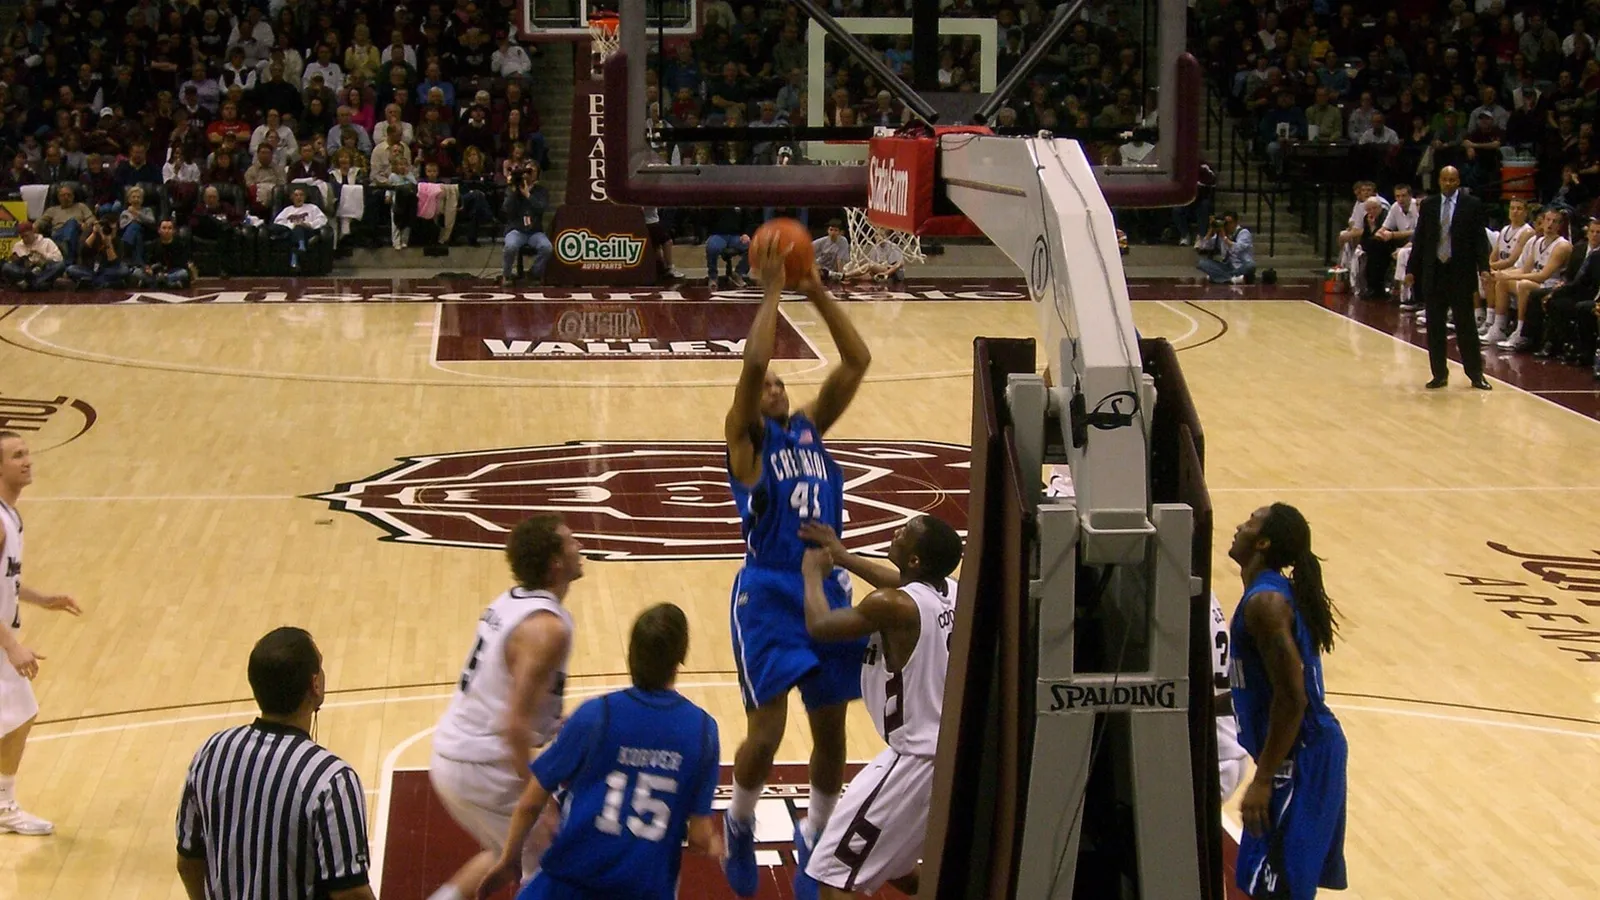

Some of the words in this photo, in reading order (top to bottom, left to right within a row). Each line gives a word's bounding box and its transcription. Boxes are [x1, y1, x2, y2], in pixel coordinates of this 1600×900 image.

[588, 93, 608, 202] BEARS
[558, 232, 641, 263] O'Reilly
[483, 338, 748, 354] VALLEY
[790, 481, 821, 518] 41
[1050, 682, 1177, 711] SPALDING
[617, 746, 684, 772] KORVER
[594, 770, 679, 842] 15
